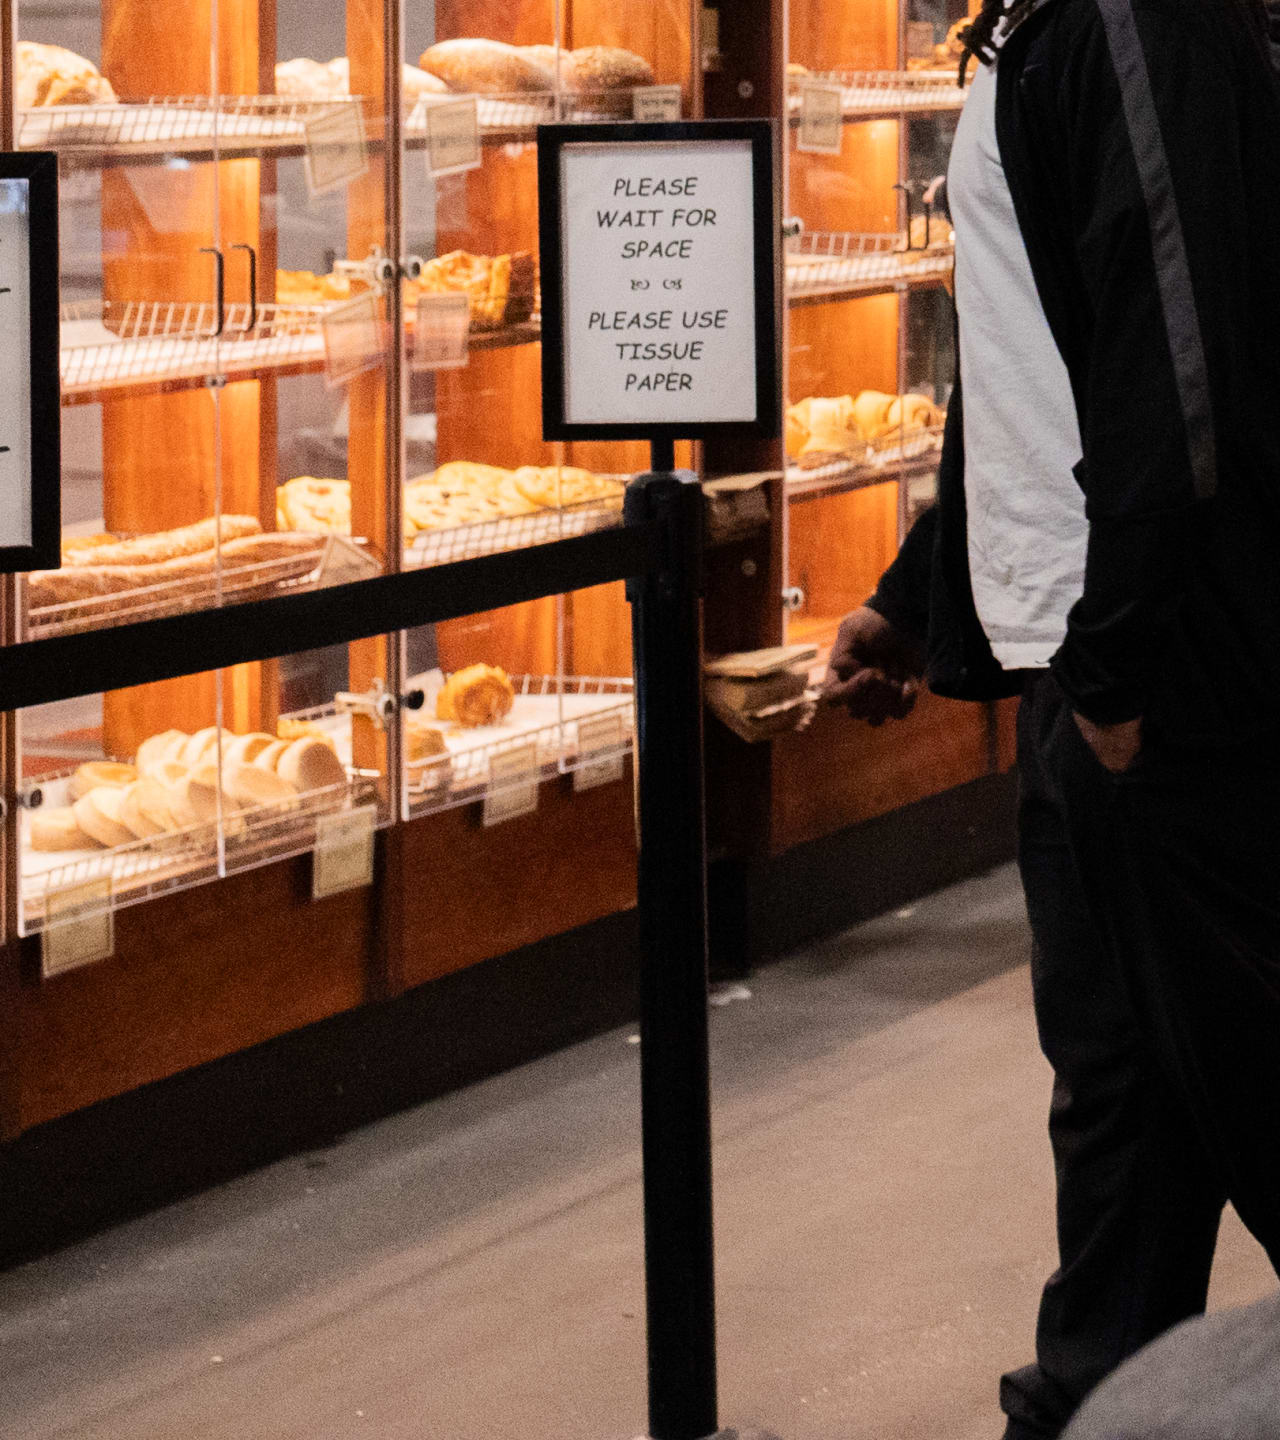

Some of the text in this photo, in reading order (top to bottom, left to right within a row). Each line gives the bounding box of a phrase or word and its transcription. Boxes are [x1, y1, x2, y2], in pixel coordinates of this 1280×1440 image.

[613, 177, 698, 197] PLEASE
[596, 208, 717, 227] WAIT FOR
[621, 240, 693, 259] SPACE
[588, 309, 728, 330] PLEASE USE
[615, 341, 704, 360] TISSUE
[625, 372, 692, 391] PAPER
